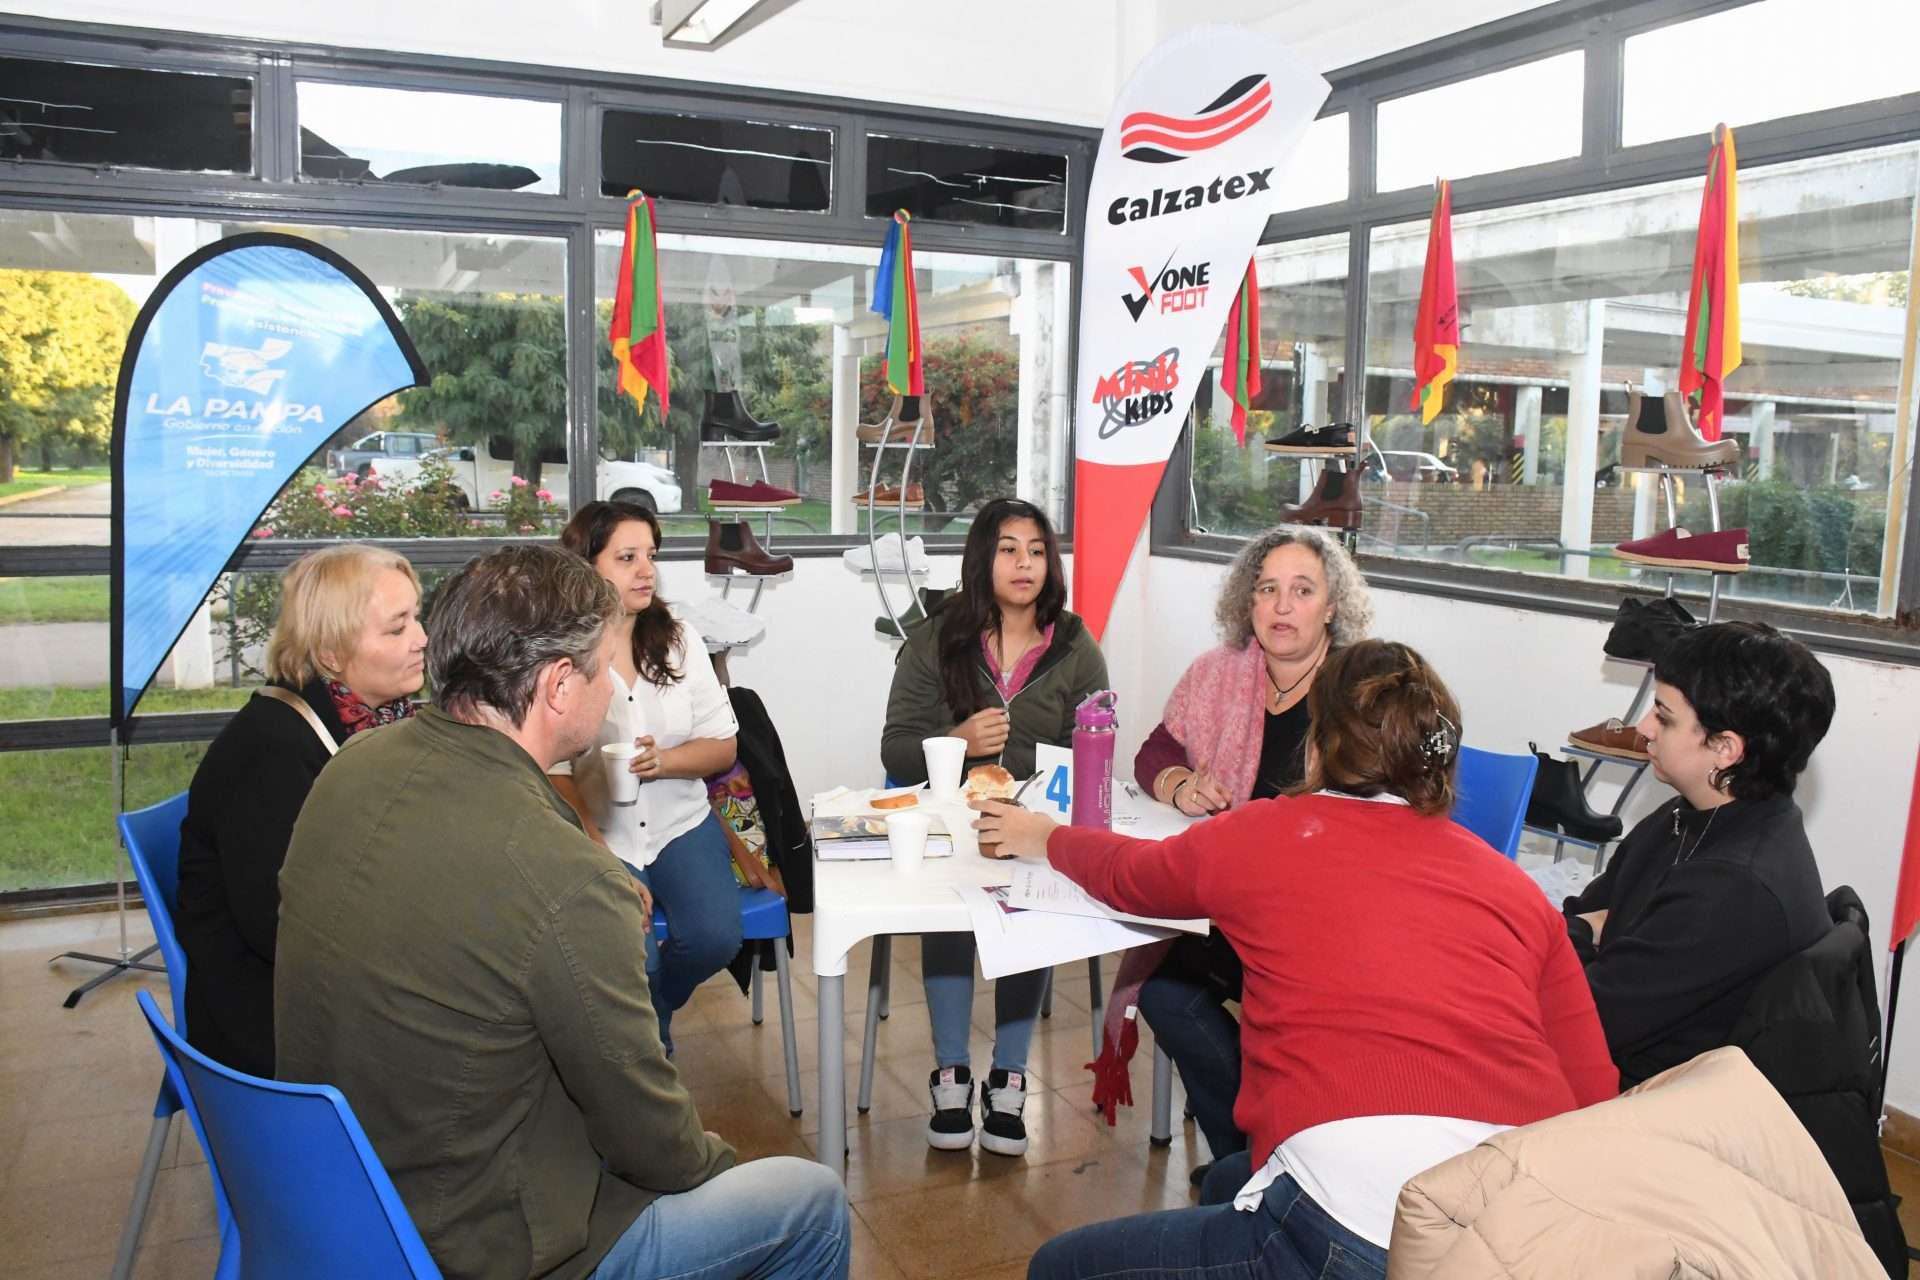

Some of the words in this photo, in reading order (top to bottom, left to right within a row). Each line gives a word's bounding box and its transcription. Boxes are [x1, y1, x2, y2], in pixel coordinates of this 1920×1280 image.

[1161, 262, 1210, 292] ONE
[1160, 287, 1209, 315] FOOT
[146, 393, 192, 417] LA
[1125, 391, 1174, 426] KIDS
[163, 417, 230, 432] Gobierno
[233, 422, 251, 432] en
[186, 459, 195, 470] y
[1046, 765, 1071, 813] 4
